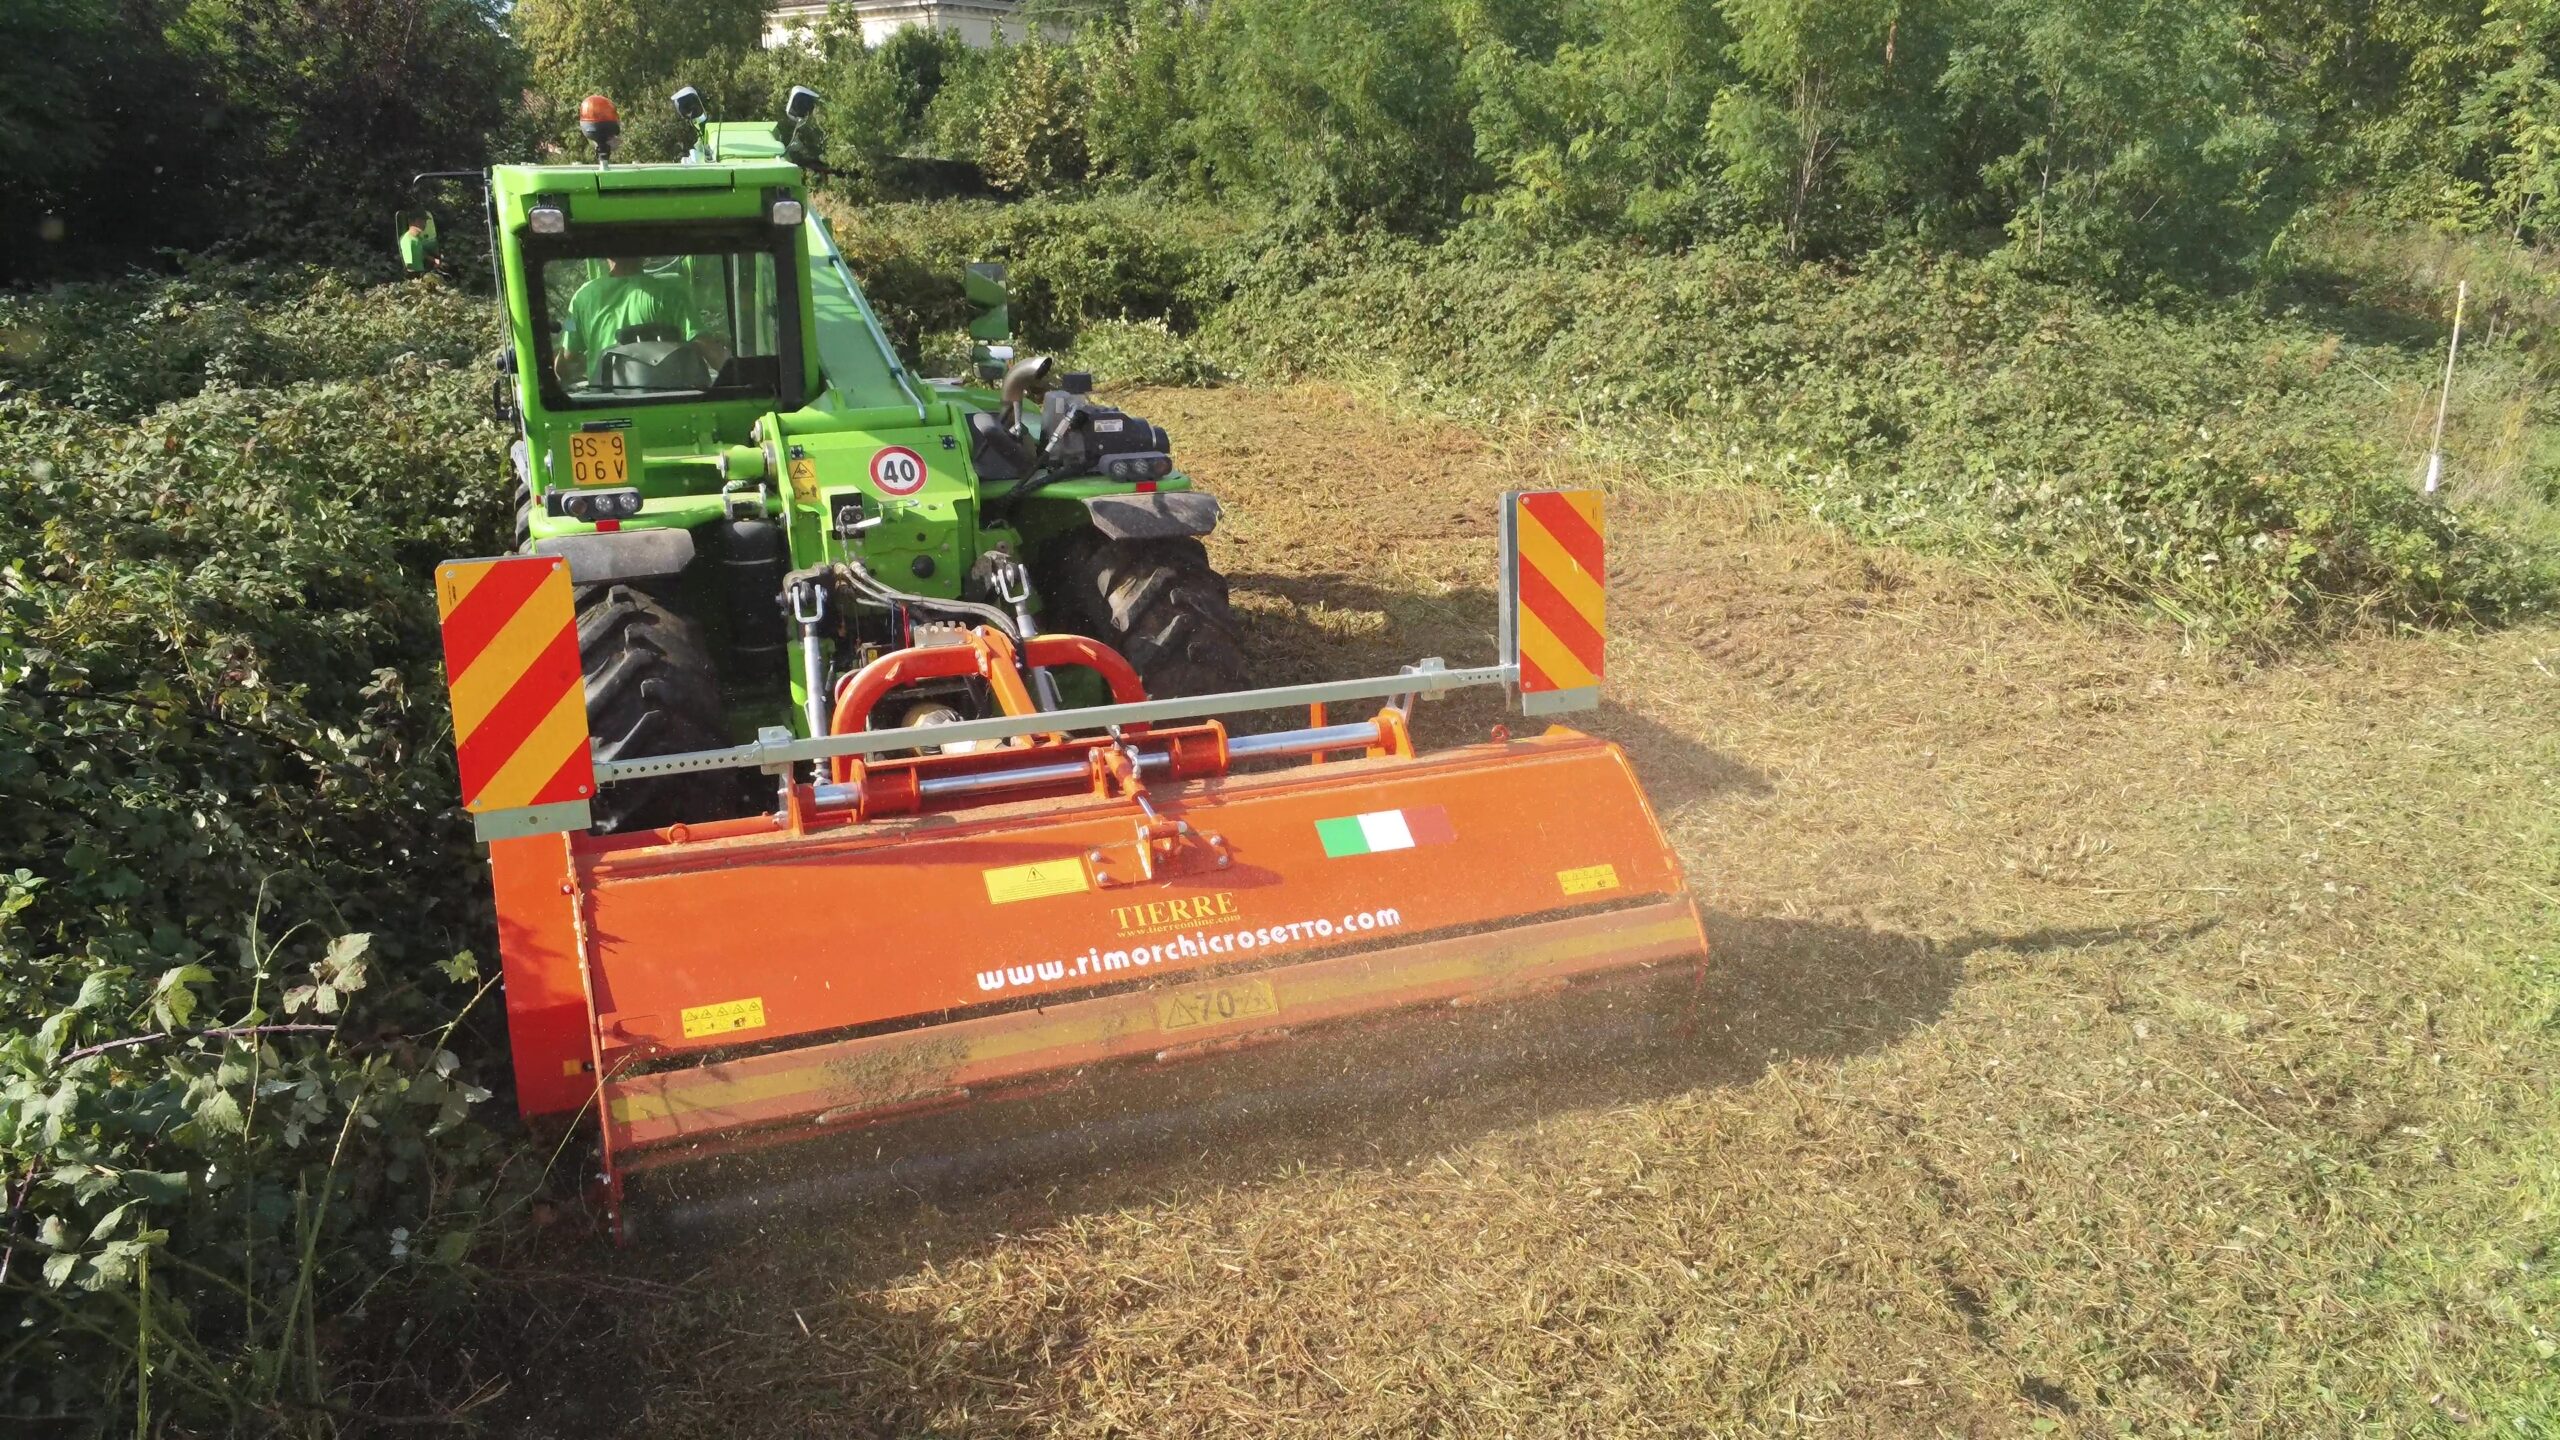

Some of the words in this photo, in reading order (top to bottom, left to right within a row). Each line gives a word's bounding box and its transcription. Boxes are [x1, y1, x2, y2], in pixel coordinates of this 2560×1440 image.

[573, 437, 598, 458] BS
[611, 436, 623, 456] 9
[883, 459, 916, 483] 40
[1110, 891, 1238, 930] TIERRE
[1116, 913, 1241, 938] www.tierreonline.com
[1195, 989, 1236, 1022] 70
